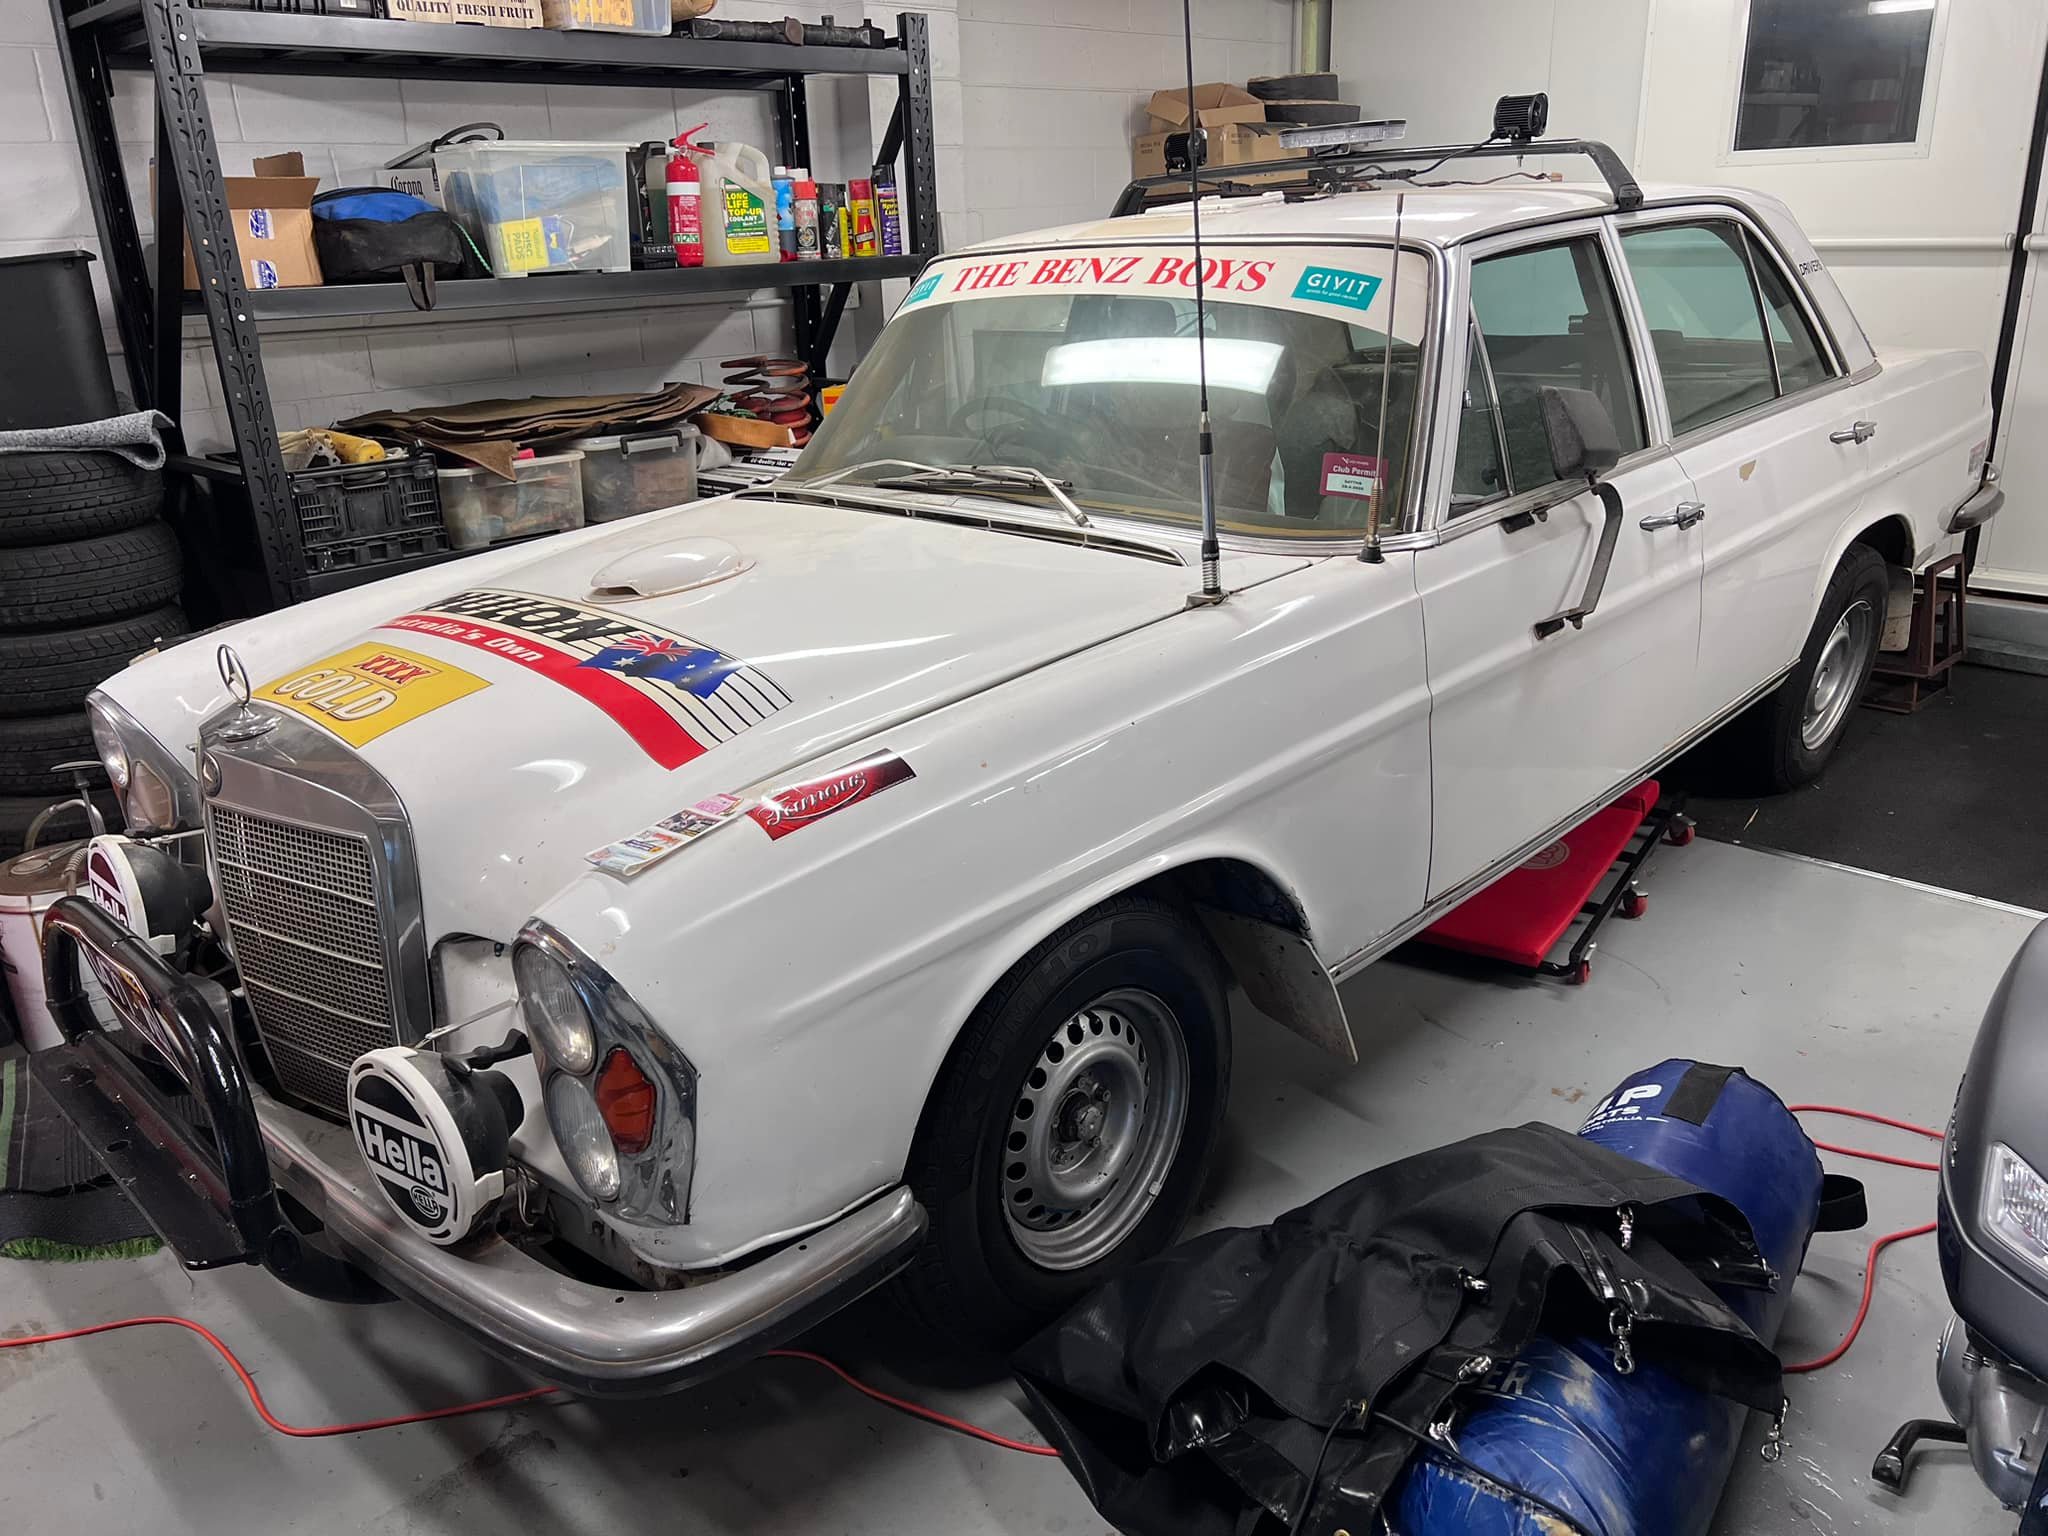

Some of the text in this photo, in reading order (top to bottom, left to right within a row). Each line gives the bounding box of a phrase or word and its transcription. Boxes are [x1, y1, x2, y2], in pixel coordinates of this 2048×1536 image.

[397, 2, 535, 20] QUALITY FRESH FRUIT
[727, 200, 749, 209] LIFE
[728, 208, 763, 216] TOP-UP
[951, 256, 1275, 293] THE BENZ BOYS
[1307, 273, 1371, 296] GIVIT
[1332, 465, 1351, 474] Club
[392, 618, 546, 663] stralia's Own
[352, 655, 431, 685] XXXX
[272, 669, 399, 722] GOLD
[92, 882, 129, 929] Hella
[360, 1116, 446, 1192] Hella
